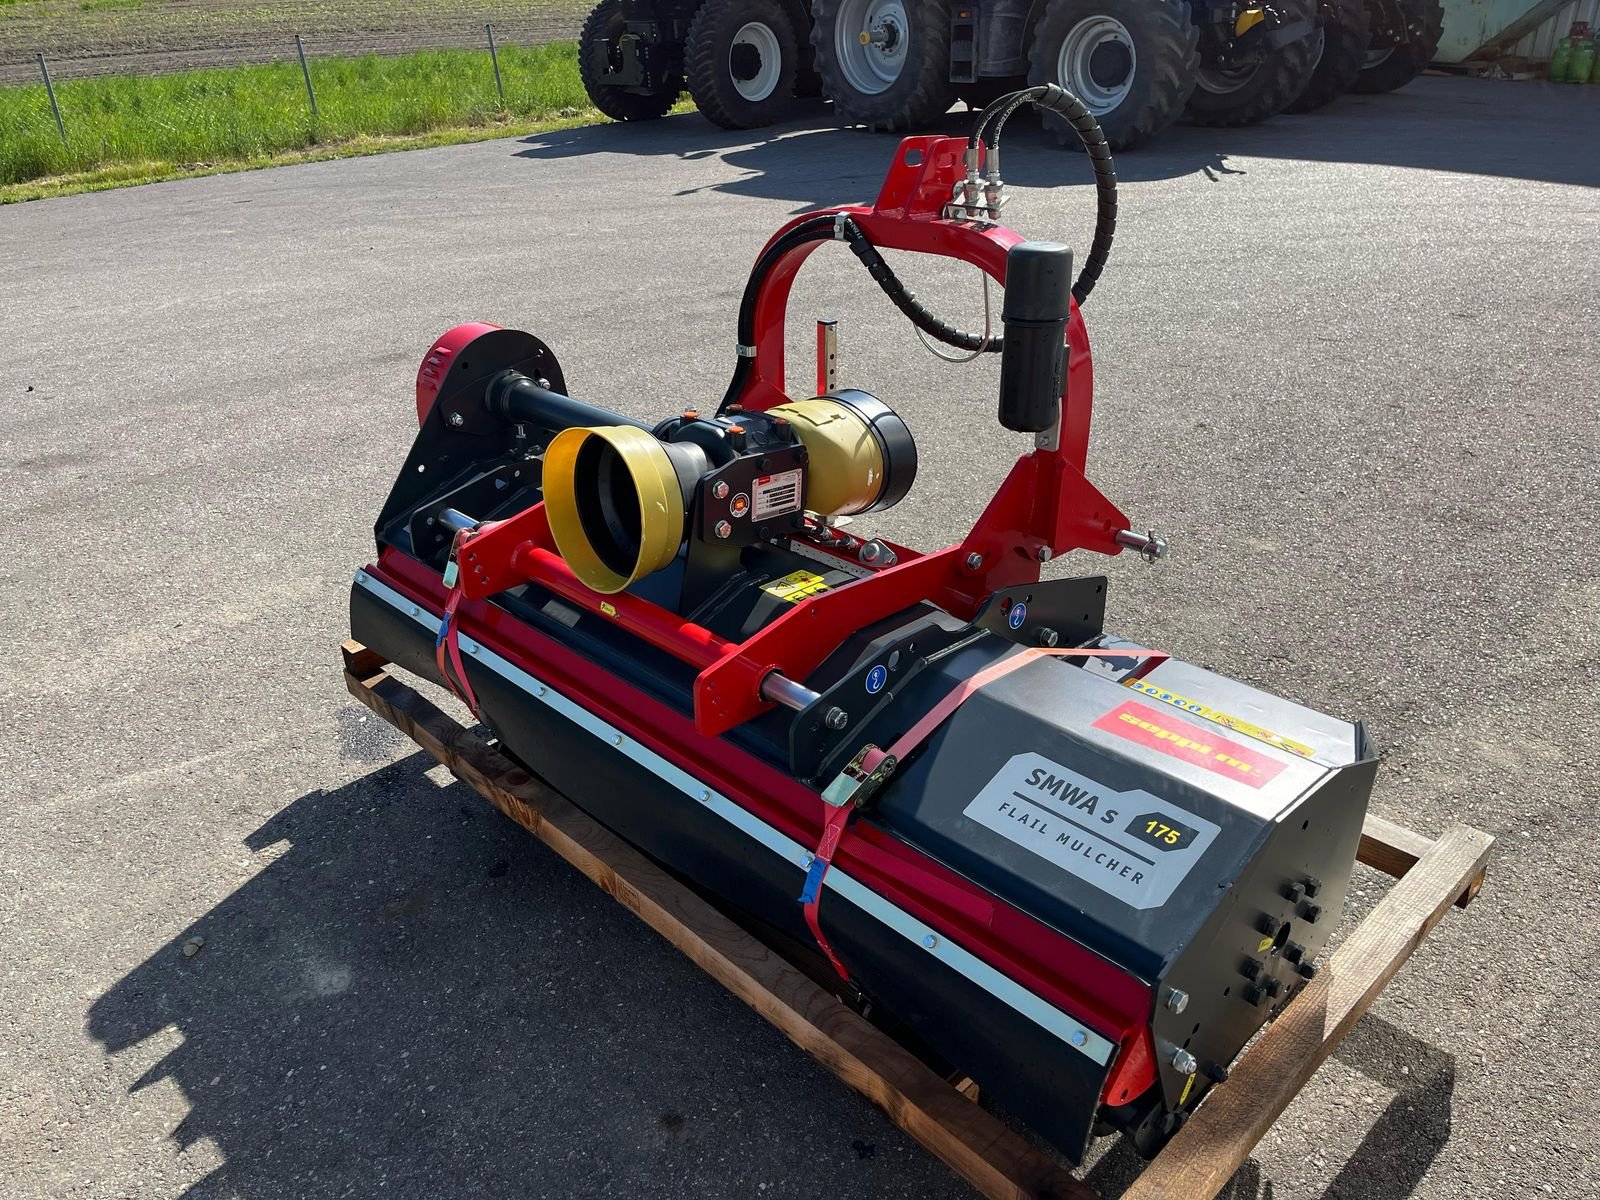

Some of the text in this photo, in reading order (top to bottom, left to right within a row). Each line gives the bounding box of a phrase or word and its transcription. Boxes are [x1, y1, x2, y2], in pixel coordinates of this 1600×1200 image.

[1119, 712, 1212, 755] seppi
[1025, 768, 1099, 815] SMWA
[998, 801, 1145, 885] FLAIL MULCHER
[1145, 820, 1180, 844] 175
